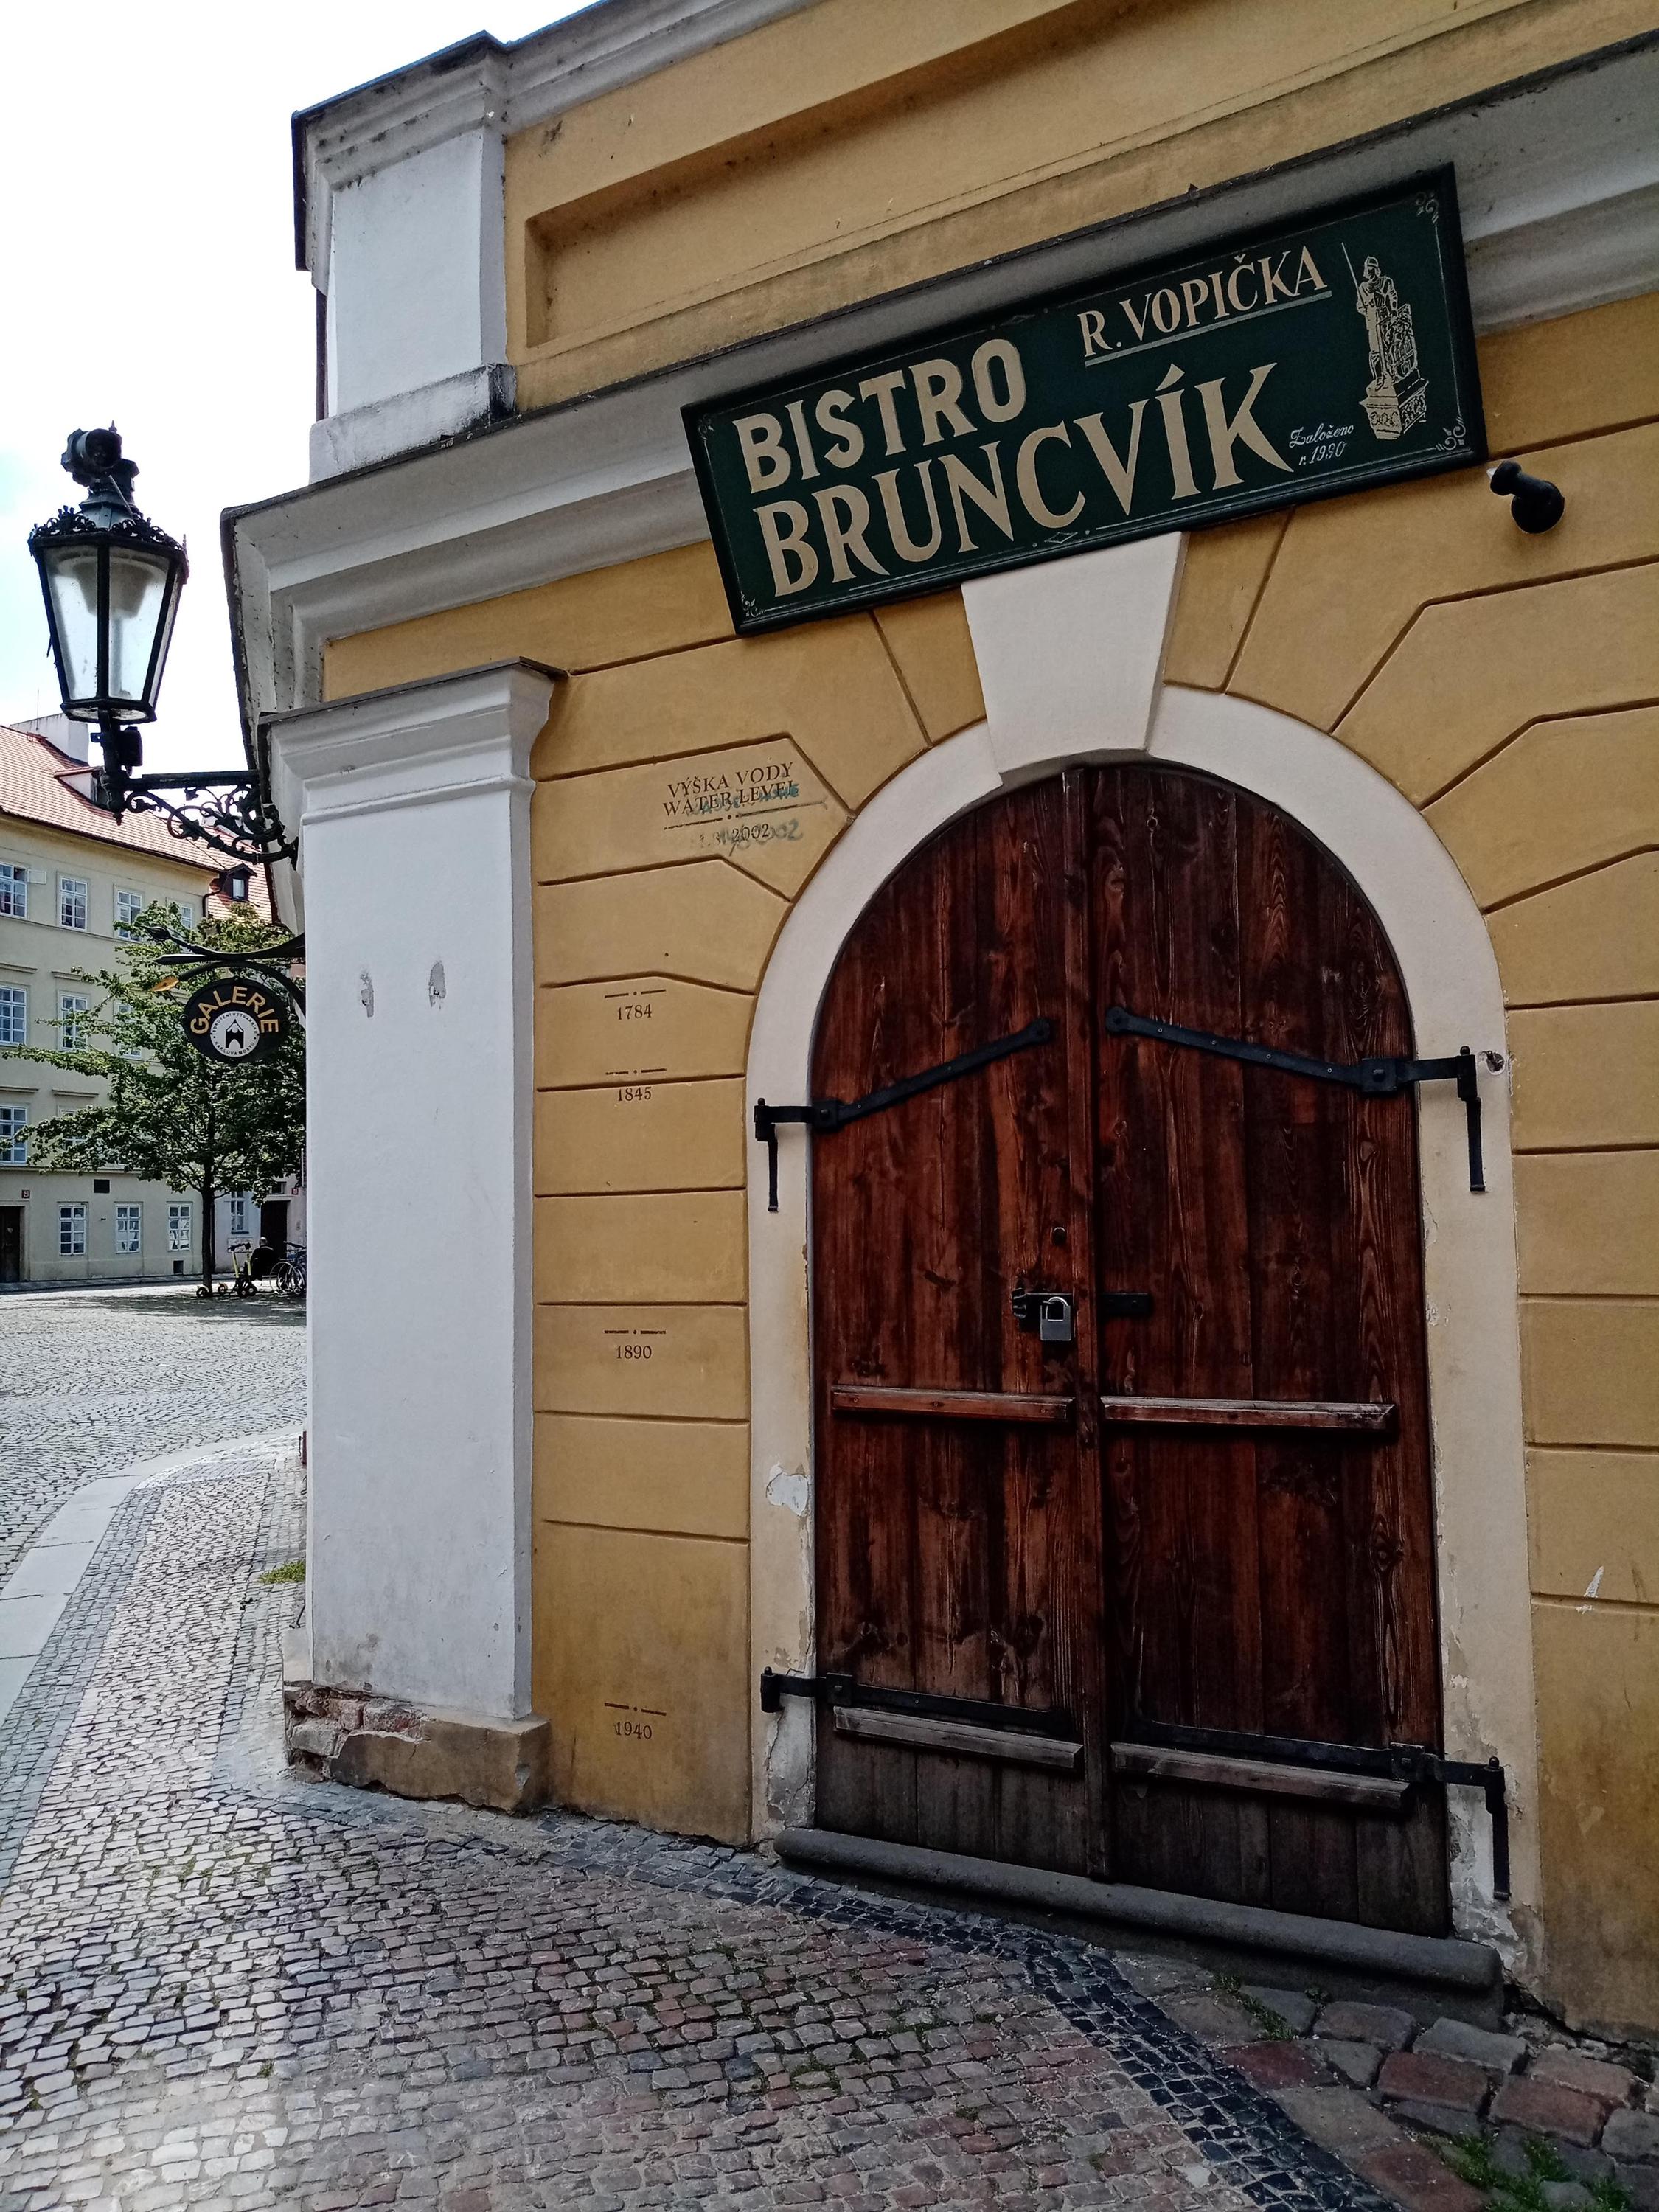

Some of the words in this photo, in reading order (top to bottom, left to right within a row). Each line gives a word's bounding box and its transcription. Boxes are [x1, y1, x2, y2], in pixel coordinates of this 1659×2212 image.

[732, 338, 1026, 495] BISTRO
[1288, 422, 1354, 448] Založeno
[754, 363, 1295, 597] BRUNCVÍK
[667, 773, 730, 799] VÝŠKA
[735, 762, 793, 786] VODY
[663, 791, 733, 817] WATER
[737, 780, 794, 804] LEVEL
[190, 986, 279, 1034] GALERIE
[618, 1004, 652, 1020] 1784
[618, 1086, 652, 1102] 1845
[616, 1345, 652, 1360] 1890
[614, 1721, 653, 1739] 1940
